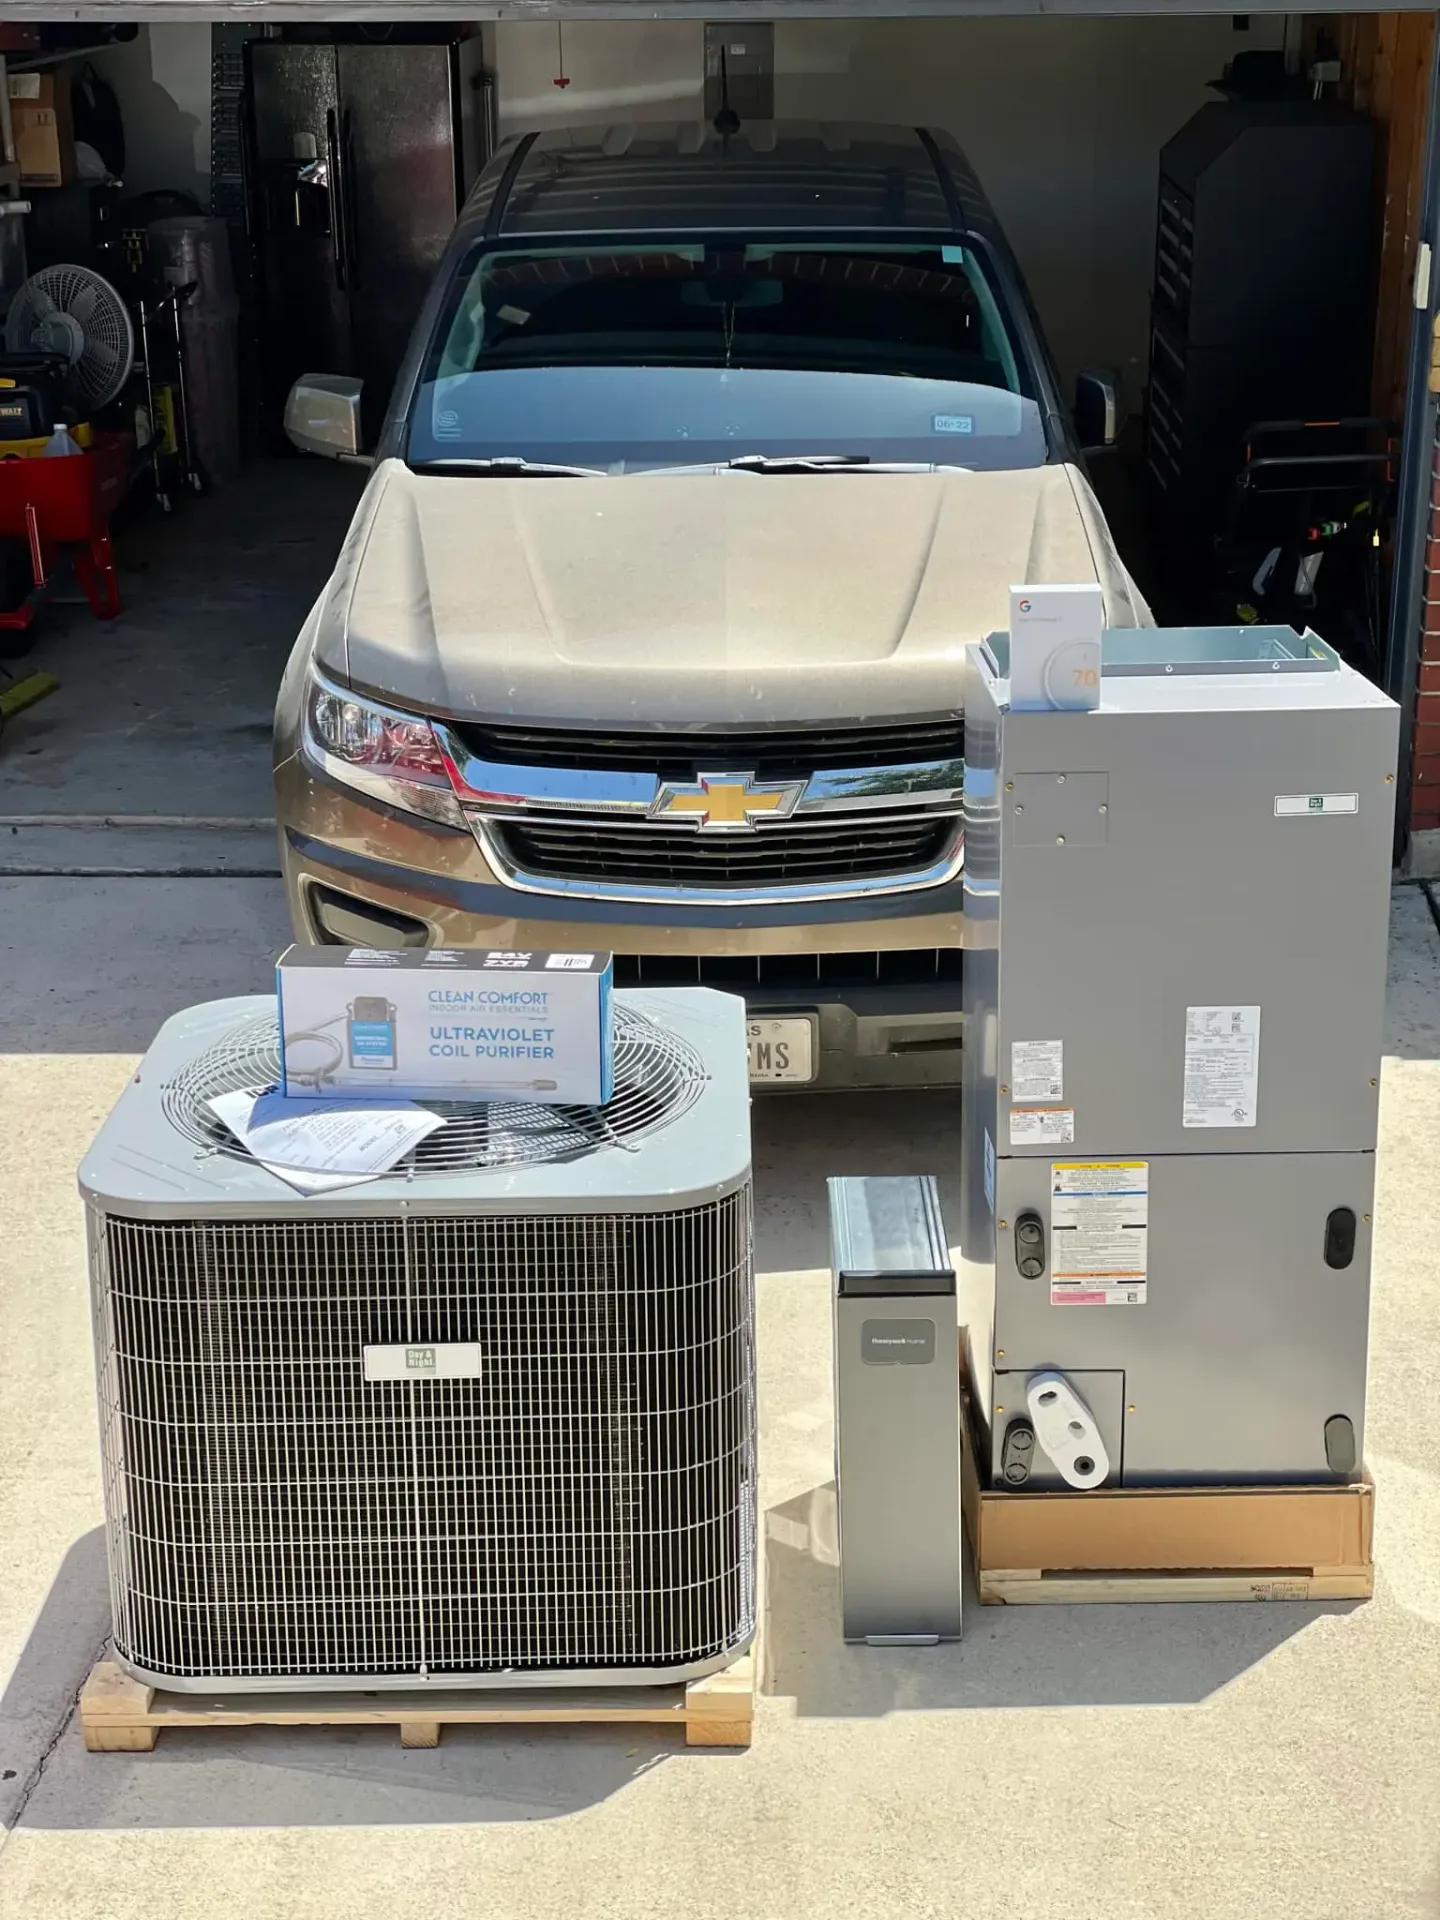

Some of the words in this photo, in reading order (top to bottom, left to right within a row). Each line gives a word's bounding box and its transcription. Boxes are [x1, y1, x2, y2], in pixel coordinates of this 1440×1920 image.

[1019, 600, 1031, 612] G
[1073, 669, 1097, 687] 70
[428, 990, 474, 1003] CLEAN
[478, 991, 548, 1005] COMFORT
[428, 1004, 467, 1012] INDOOR
[469, 1004, 487, 1012] AIR
[489, 1005, 548, 1014] ESSENTIALS
[430, 1027, 555, 1042] ULTRAVIOLET
[429, 1044, 470, 1057] COIL
[475, 1045, 554, 1059] PURIFIER
[408, 1350, 424, 1360] Day
[426, 1350, 432, 1358] &
